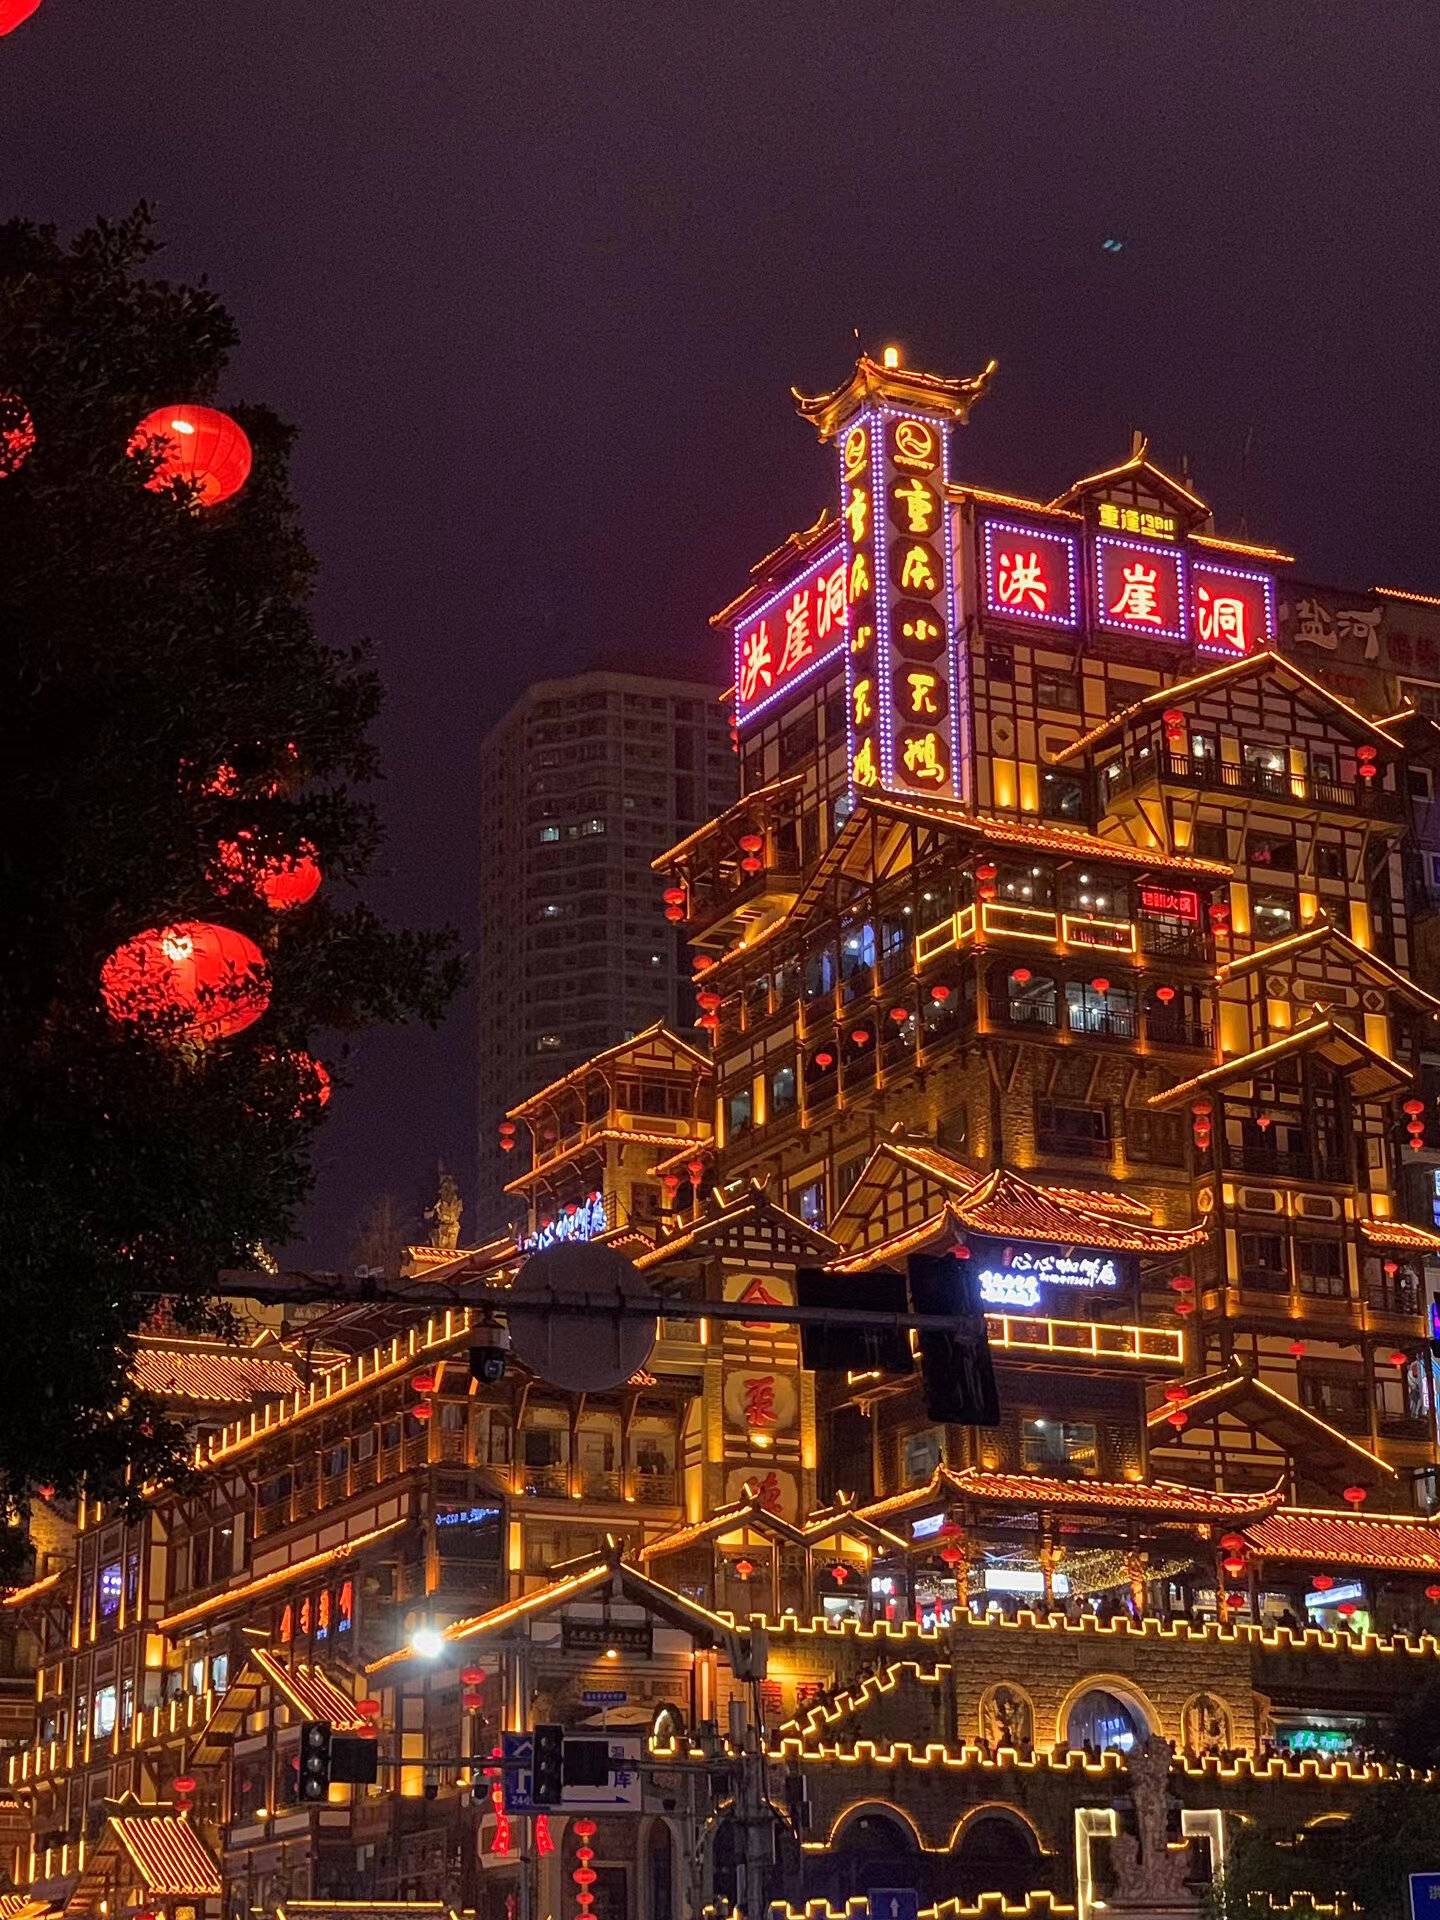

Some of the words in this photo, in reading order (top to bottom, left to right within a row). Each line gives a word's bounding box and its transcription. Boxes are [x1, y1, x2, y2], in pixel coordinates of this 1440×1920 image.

[740, 562, 848, 702] 洪崖洞
[893, 477, 946, 784] 重庆小天鹅
[997, 550, 1247, 652] 洪崖洞
